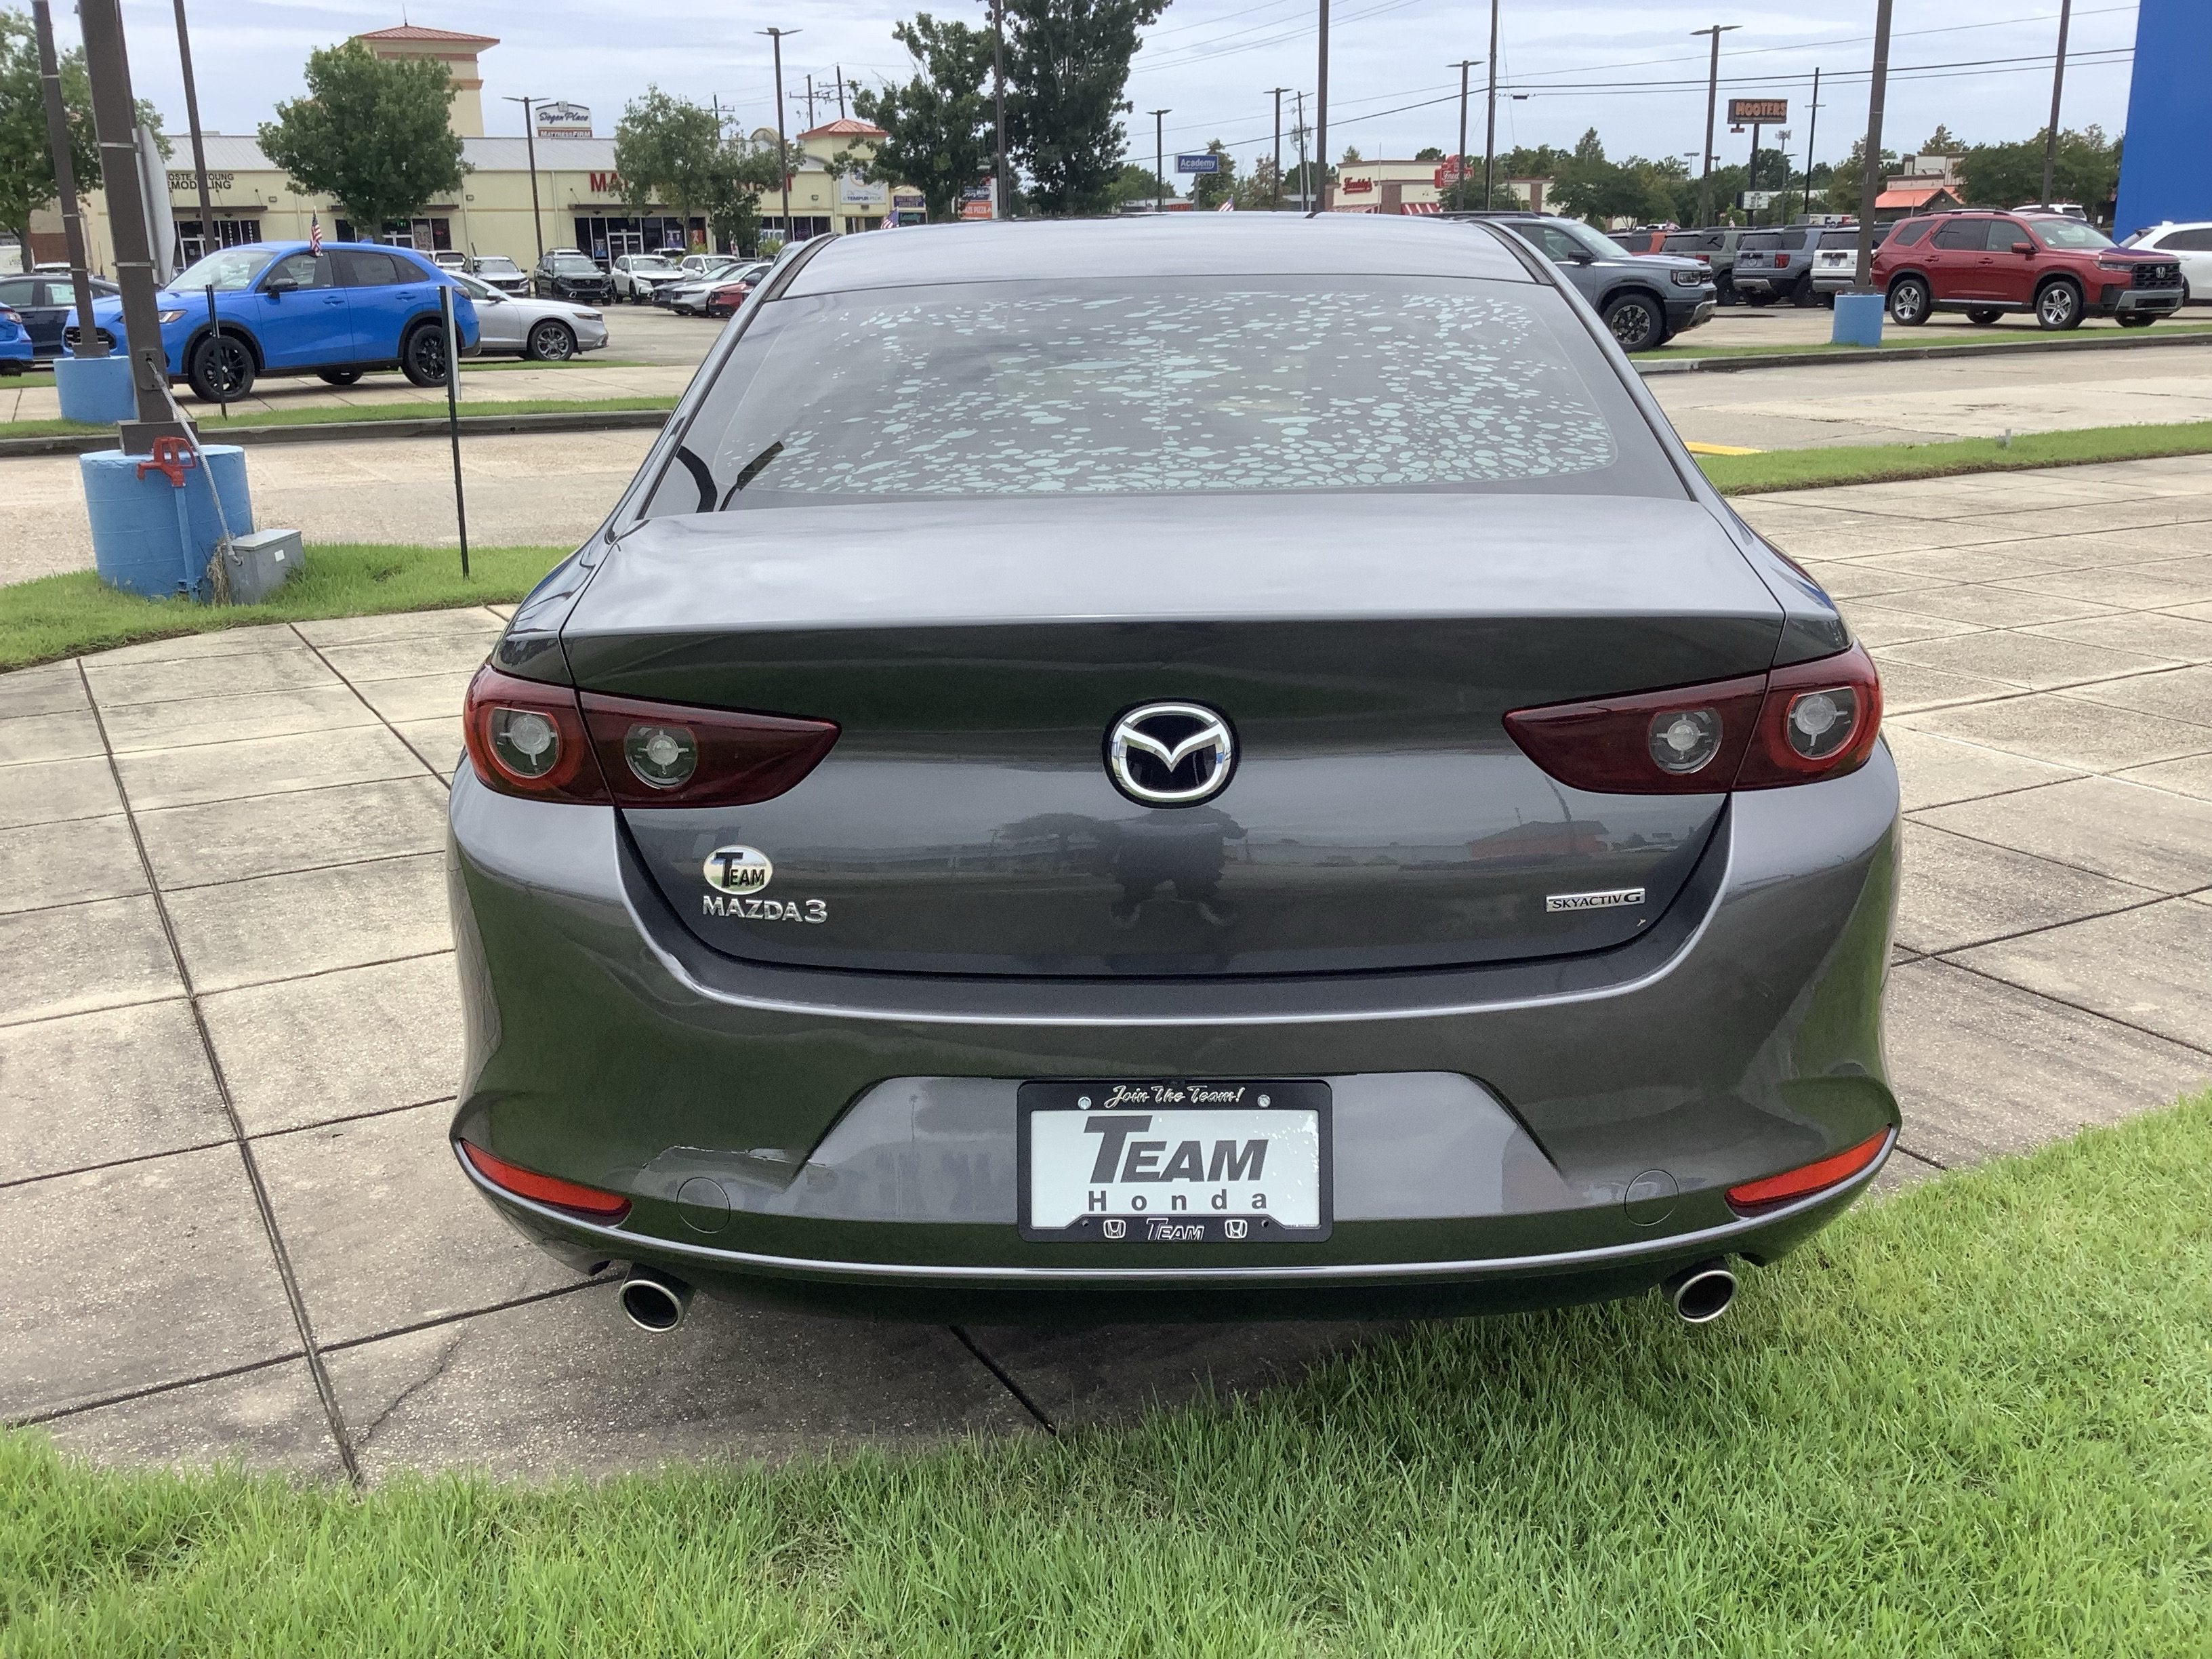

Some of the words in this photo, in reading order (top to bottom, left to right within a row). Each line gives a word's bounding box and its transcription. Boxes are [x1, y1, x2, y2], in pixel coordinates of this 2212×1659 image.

[565, 112, 588, 121] Place
[1736, 102, 1787, 117] HOOTERS
[1181, 159, 1215, 169] Academy
[714, 852, 765, 888] TEAM
[1104, 1086, 1150, 1109] Join
[1151, 1086, 1185, 1104] The
[1186, 1085, 1246, 1104] Team!
[1084, 1115, 1269, 1184] TEAM
[1088, 1189, 1267, 1212] Honda
[1146, 1218, 1205, 1241] TEAM
